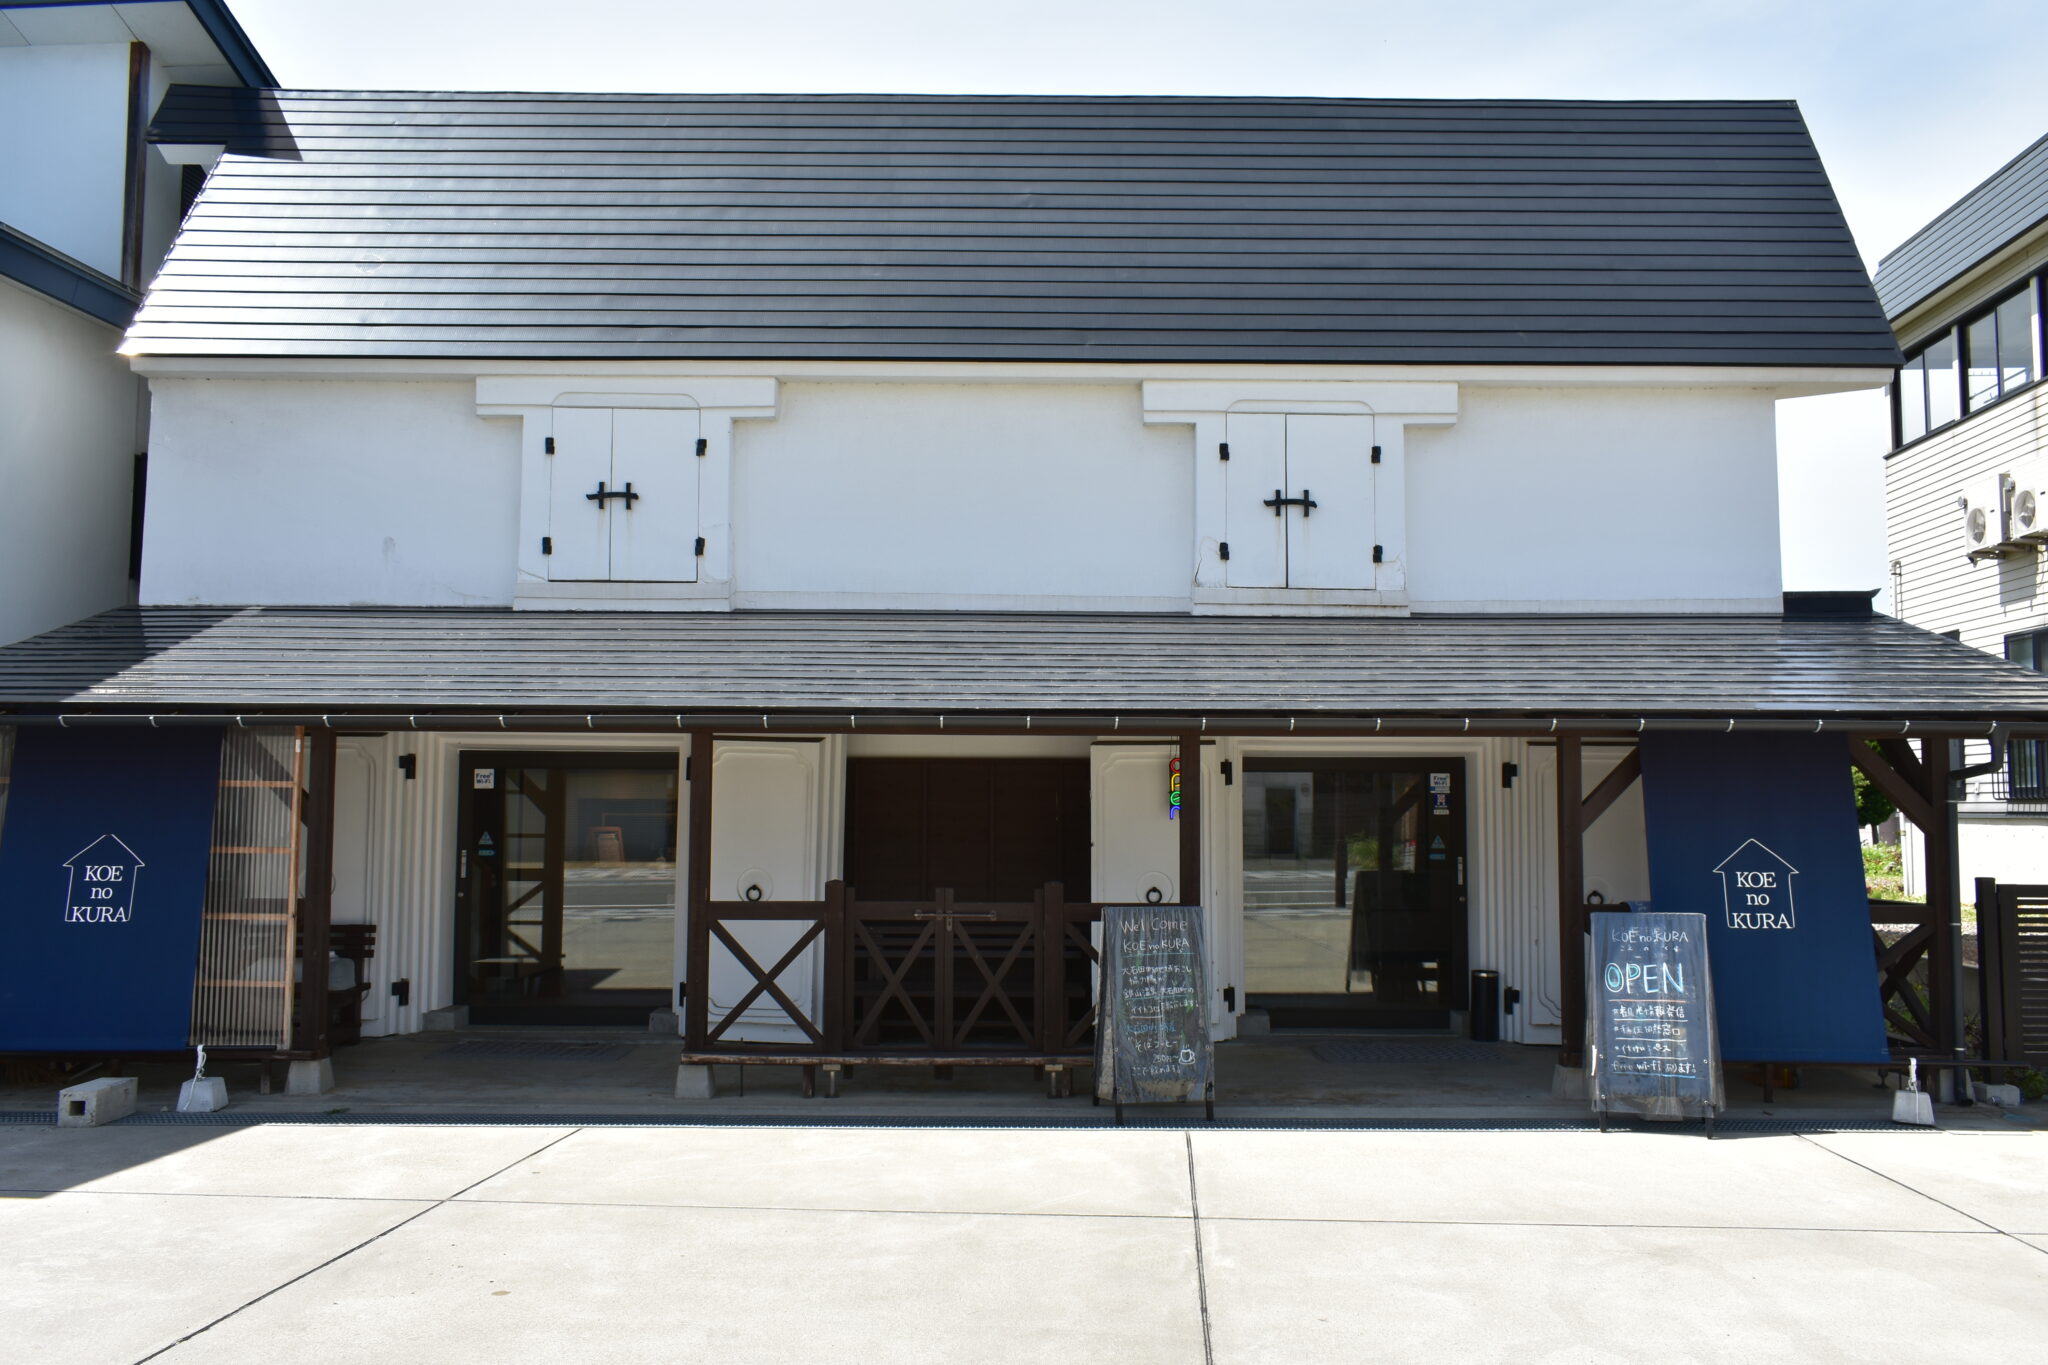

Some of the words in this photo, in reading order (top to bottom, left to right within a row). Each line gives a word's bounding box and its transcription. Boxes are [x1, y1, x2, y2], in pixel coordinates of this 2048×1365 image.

[84, 865, 124, 882] KOE
[1735, 871, 1777, 888] KOE
[90, 887, 113, 899] no
[1746, 893, 1770, 906] no
[71, 906, 127, 923] KURA
[1731, 912, 1792, 930] KURA
[1612, 927, 1638, 943] KOE
[1639, 934, 1652, 942] no
[1653, 928, 1689, 943] KURA
[1123, 939, 1146, 953] KOE
[1161, 937, 1190, 950] KURA
[1604, 961, 1684, 995] OPEN
